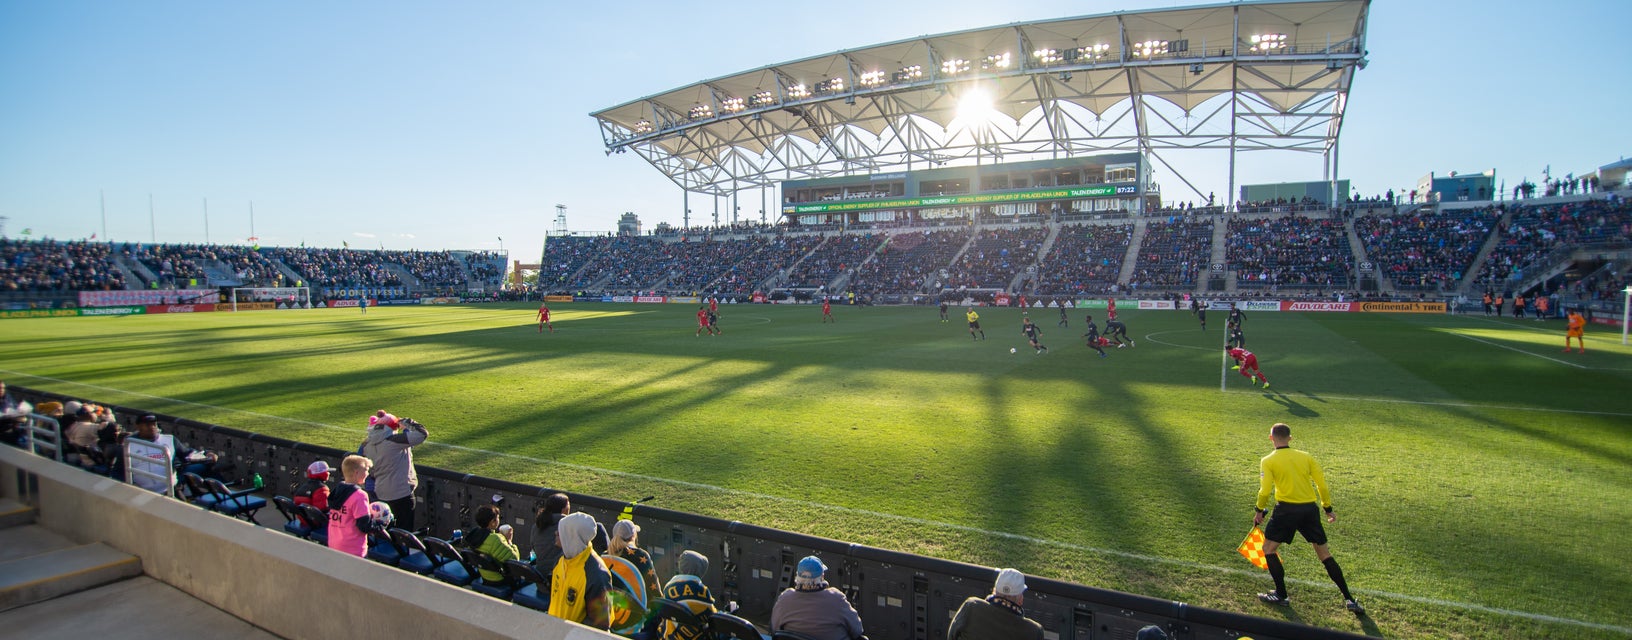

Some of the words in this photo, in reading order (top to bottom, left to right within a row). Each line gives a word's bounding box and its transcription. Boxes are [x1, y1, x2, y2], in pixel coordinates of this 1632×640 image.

[1021, 192, 1052, 200] PHILADELPHIA
[1289, 302, 1350, 311] ADVOCARE
[1362, 302, 1413, 311] Continental
